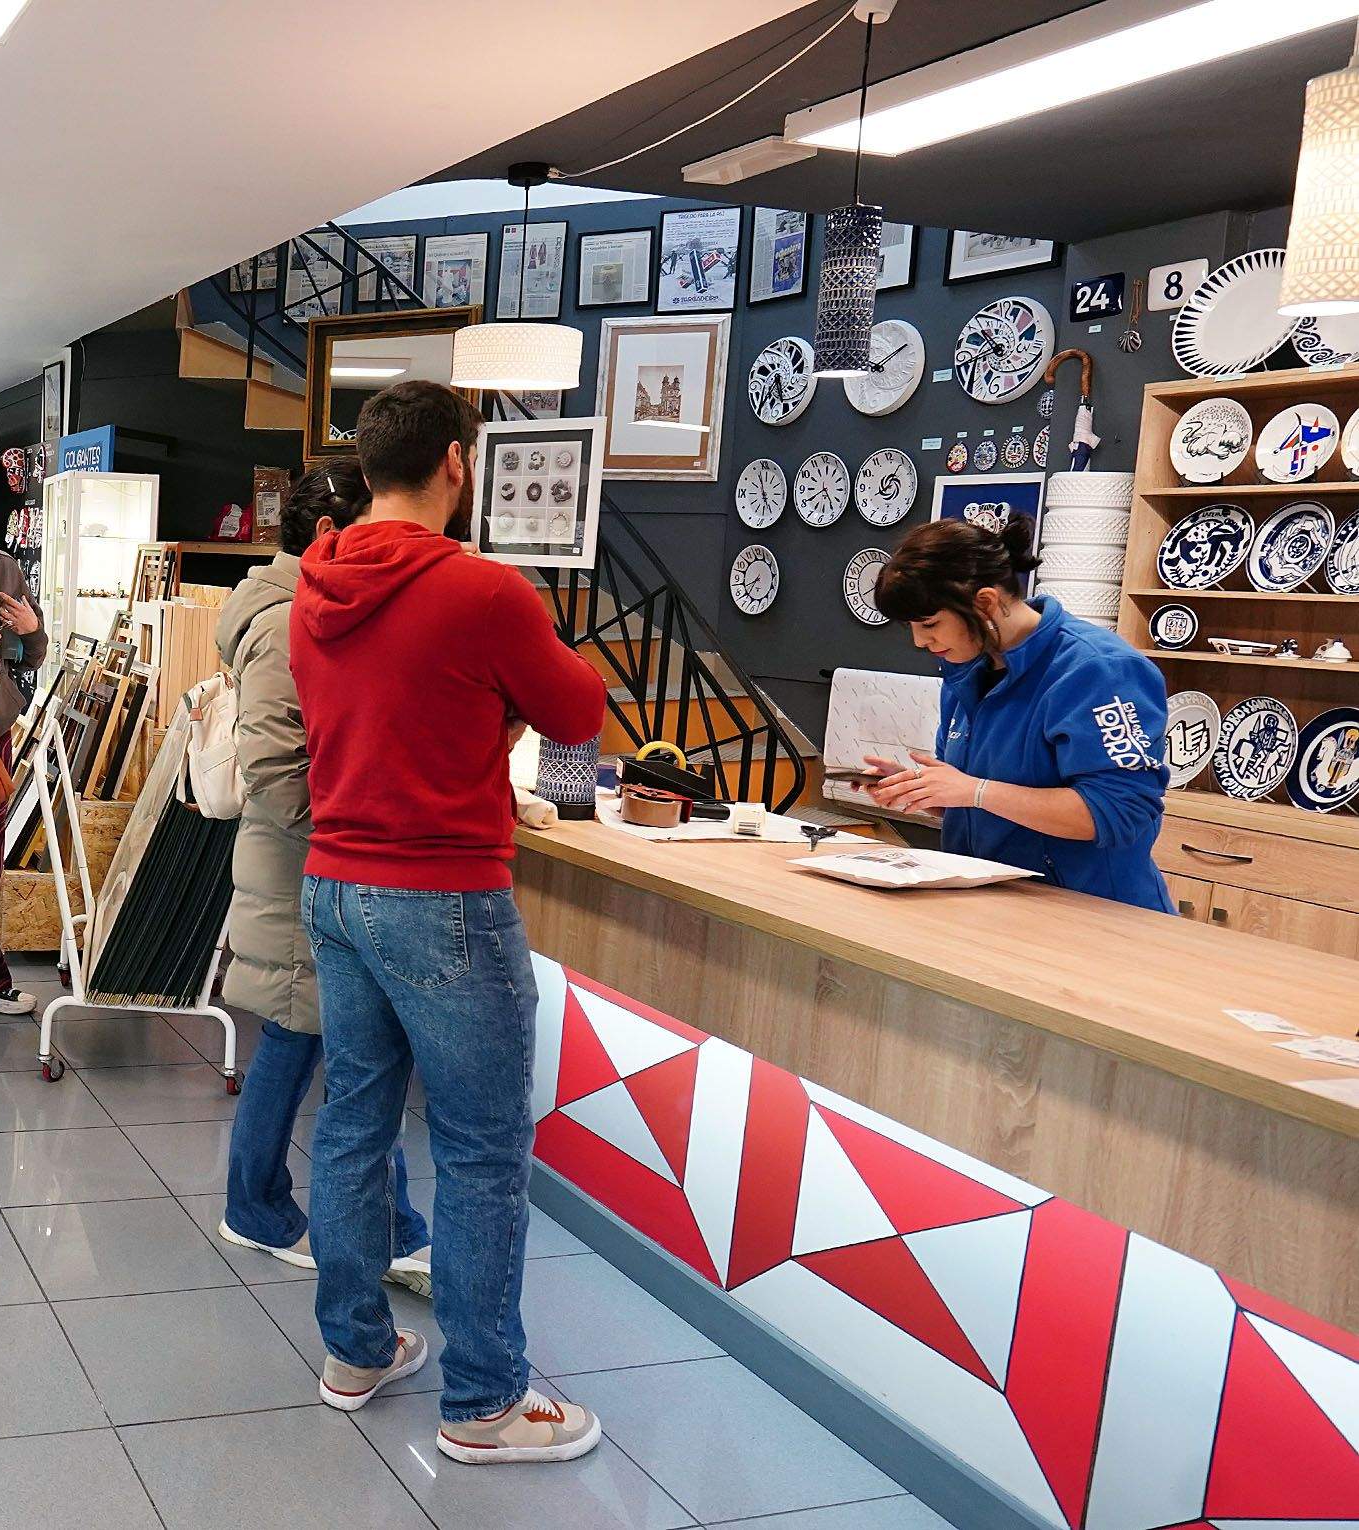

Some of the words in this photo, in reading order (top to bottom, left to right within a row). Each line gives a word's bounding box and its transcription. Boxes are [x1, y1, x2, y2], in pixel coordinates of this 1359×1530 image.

[1164, 271, 1183, 300] 8
[1076, 283, 1110, 314] 24
[65, 446, 101, 468] COLGANTES
[821, 455, 830, 464] 12
[885, 452, 894, 460] 12
[872, 457, 880, 465] 11
[802, 469, 810, 478] 10
[862, 469, 871, 477] 10
[799, 485, 805, 494] 9
[859, 484, 865, 492] 9
[738, 488, 746, 498] IX
[801, 499, 807, 508] 8
[861, 498, 868, 507] 8
[870, 510, 876, 518] 7
[755, 548, 761, 556] 12
[737, 561, 745, 569] 10
[849, 582, 855, 590] 9
[853, 596, 859, 605] 8
